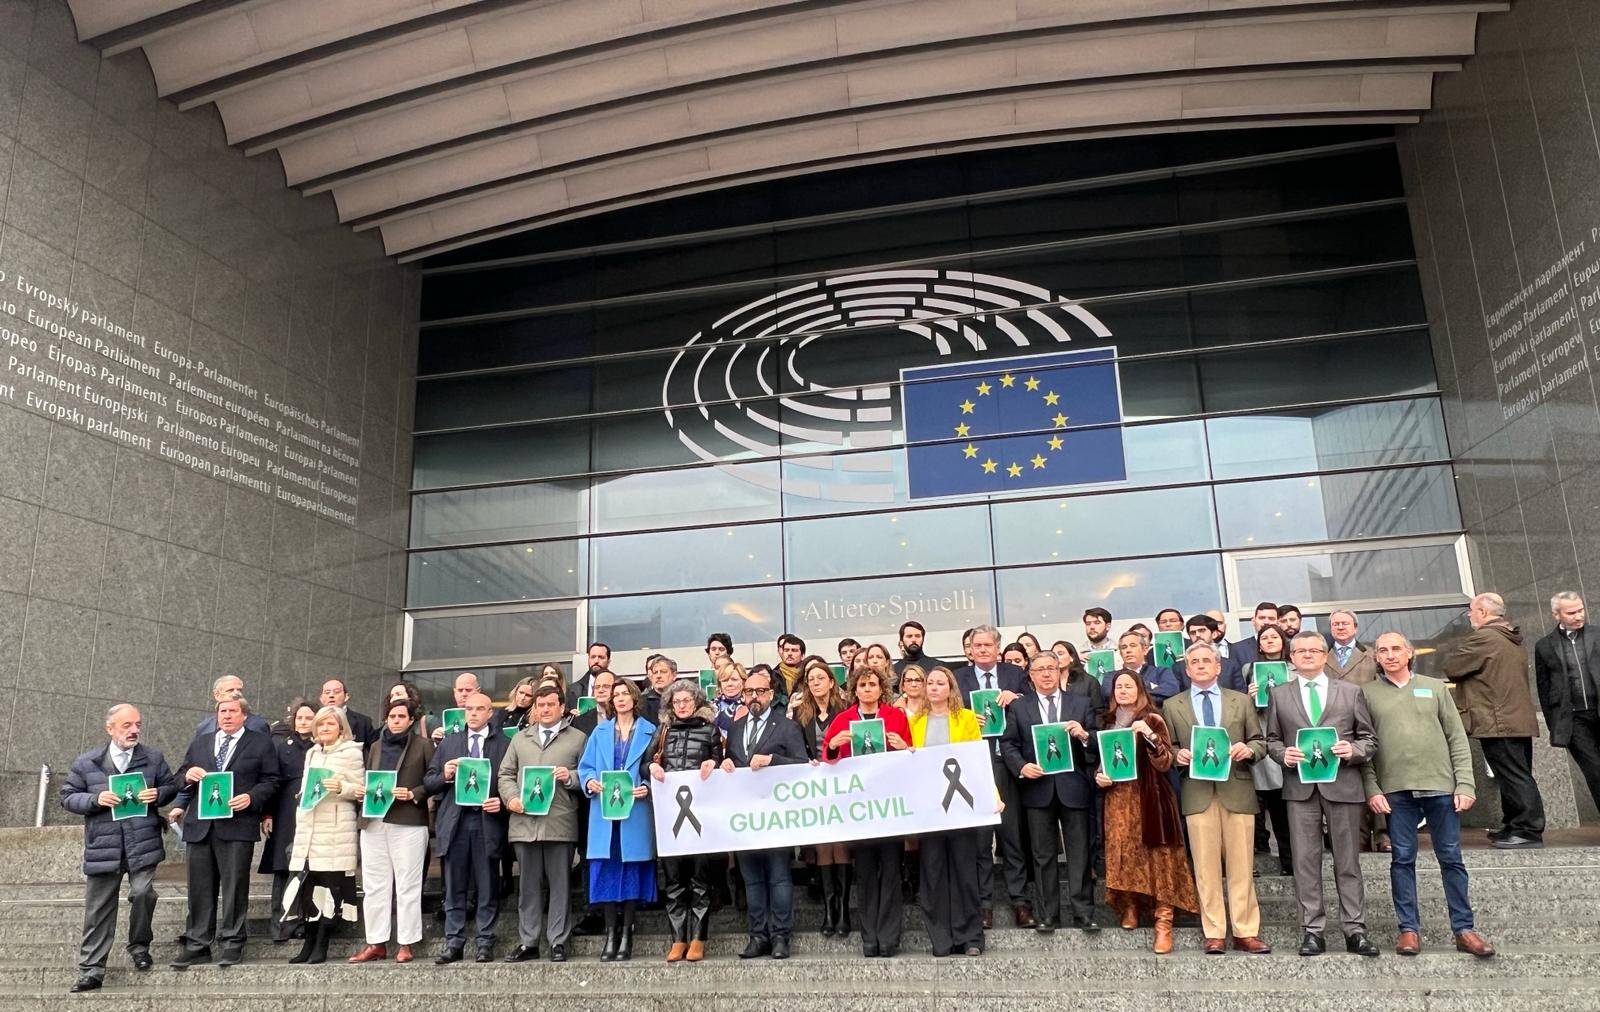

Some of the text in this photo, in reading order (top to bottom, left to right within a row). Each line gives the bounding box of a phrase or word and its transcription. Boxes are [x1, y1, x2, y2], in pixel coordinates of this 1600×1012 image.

[1535, 241, 1585, 289] парламент
[1490, 319, 1522, 352] Euroopa
[1523, 283, 1568, 326] Parlament
[1494, 341, 1528, 374] Europski
[1530, 306, 1576, 350] parlament
[17, 276, 359, 446] Evropský parlament Europa-Parlamentet Europäisches Parlament
[28, 309, 91, 349] European
[95, 338, 160, 380] Parliament
[169, 373, 223, 405] Parlement
[225, 401, 269, 427] européen
[276, 421, 319, 450] Parlaimint
[322, 445, 331, 455] na
[1498, 361, 1540, 396] Parlament
[1541, 332, 1583, 367] Ewropew
[1541, 356, 1589, 399] parlament
[9, 356, 81, 397] Parlament
[84, 387, 148, 423] Europejski
[157, 416, 218, 451] Parlamento
[221, 442, 259, 467] Europeu
[267, 460, 319, 490] Parlamentul
[321, 482, 357, 505] European
[49, 346, 96, 377] Eiropas
[101, 368, 167, 407] Parlaments
[176, 400, 217, 427] Europos
[220, 418, 278, 452] Parlamentas
[318, 460, 357, 487] Parlament
[26, 391, 84, 425] Evropski
[88, 416, 151, 450] parlament
[160, 442, 211, 472] Euroopan
[214, 464, 271, 493] parlamentti
[277, 485, 355, 525] Europaparlamentet
[805, 589, 976, 621] Altiero Spinelli
[730, 796, 914, 832] GUARDIA CIVIL
[773, 773, 864, 802] CON LA
